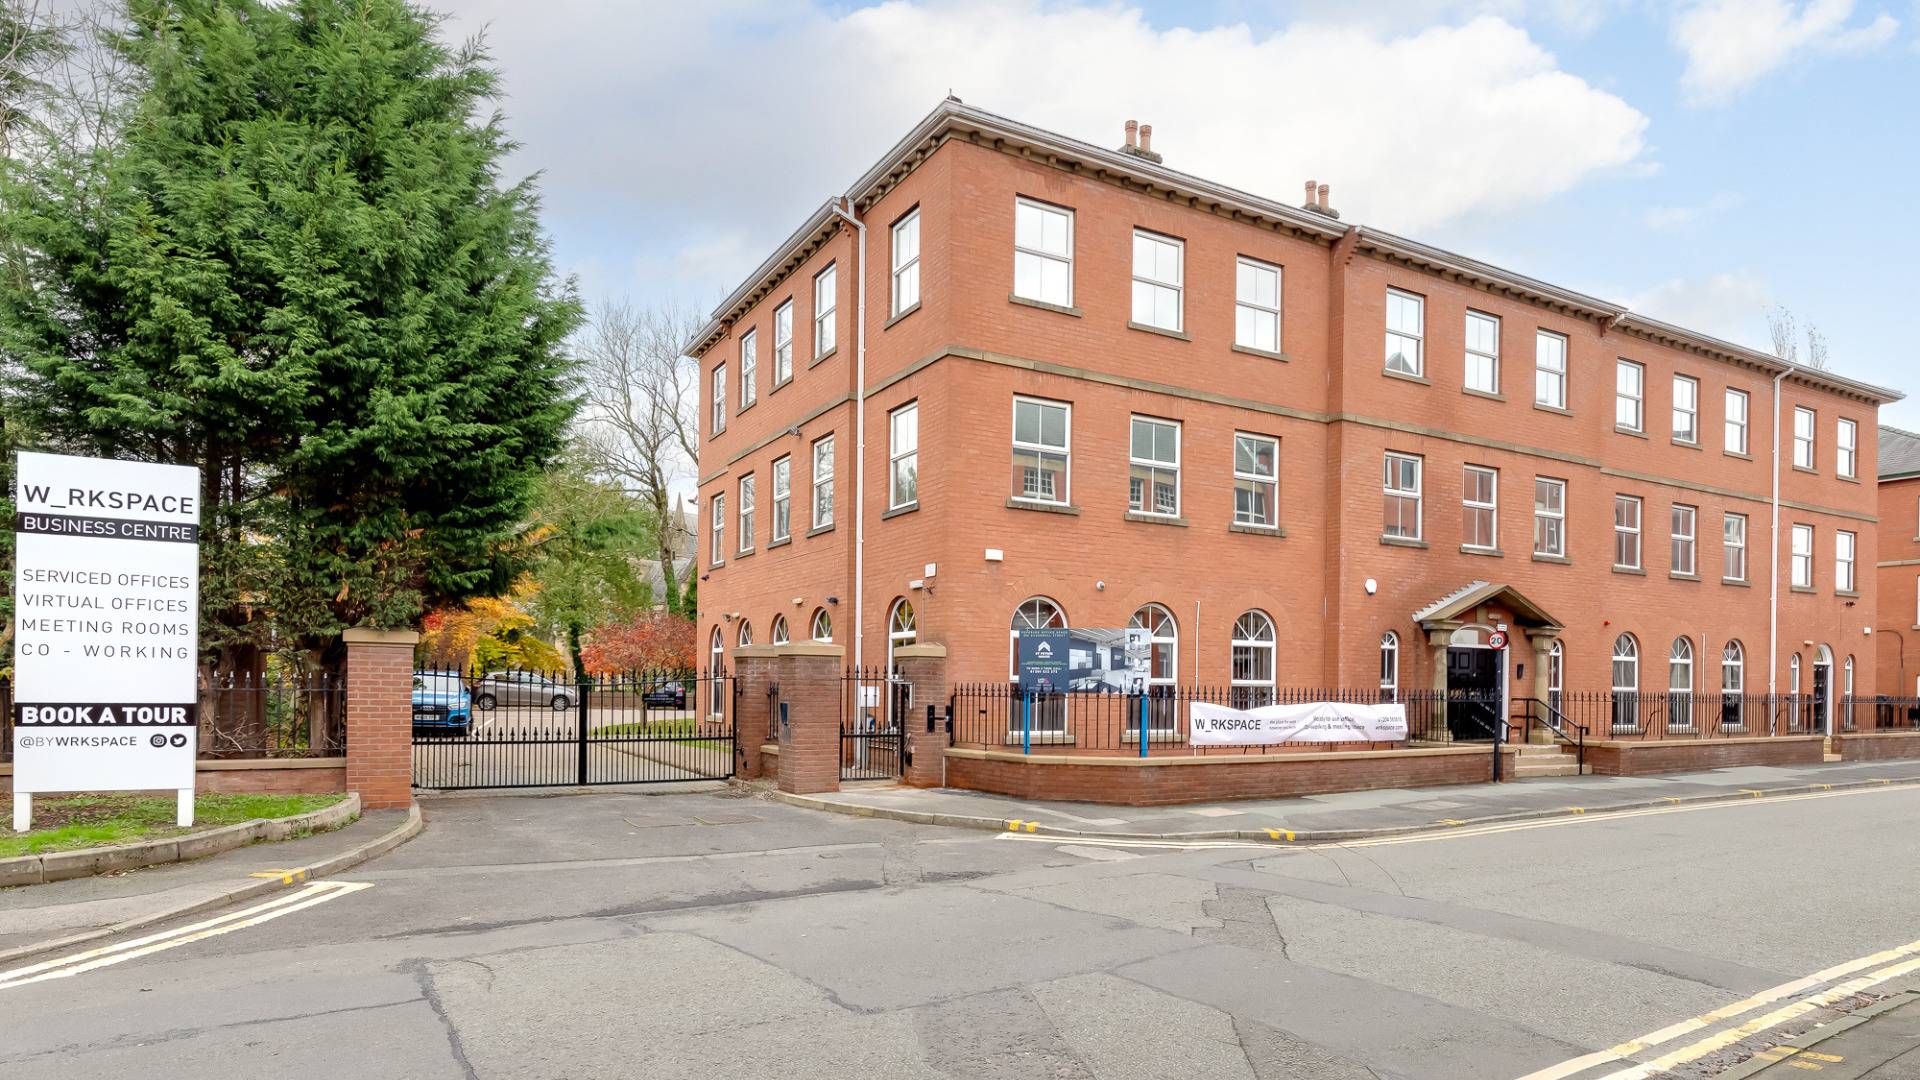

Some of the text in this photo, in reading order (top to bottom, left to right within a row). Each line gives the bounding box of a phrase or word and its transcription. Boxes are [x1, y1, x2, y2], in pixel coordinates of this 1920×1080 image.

[24, 484, 194, 514] W_RKSPACE
[24, 516, 192, 540] BUSINESS CENTRE
[23, 569, 189, 589] SERVICED OFFICES
[23, 594, 188, 612] VIRTUAL OFFICES
[22, 618, 189, 636] MEETING ROOMS
[1491, 637, 1503, 645] 20
[21, 643, 50, 656] CO
[83, 645, 188, 659] WORKING
[22, 706, 187, 724] BOOK A TOUR
[1195, 719, 1261, 733] W_RKSPACE
[20, 736, 137, 748] @BYWRKSPACE
